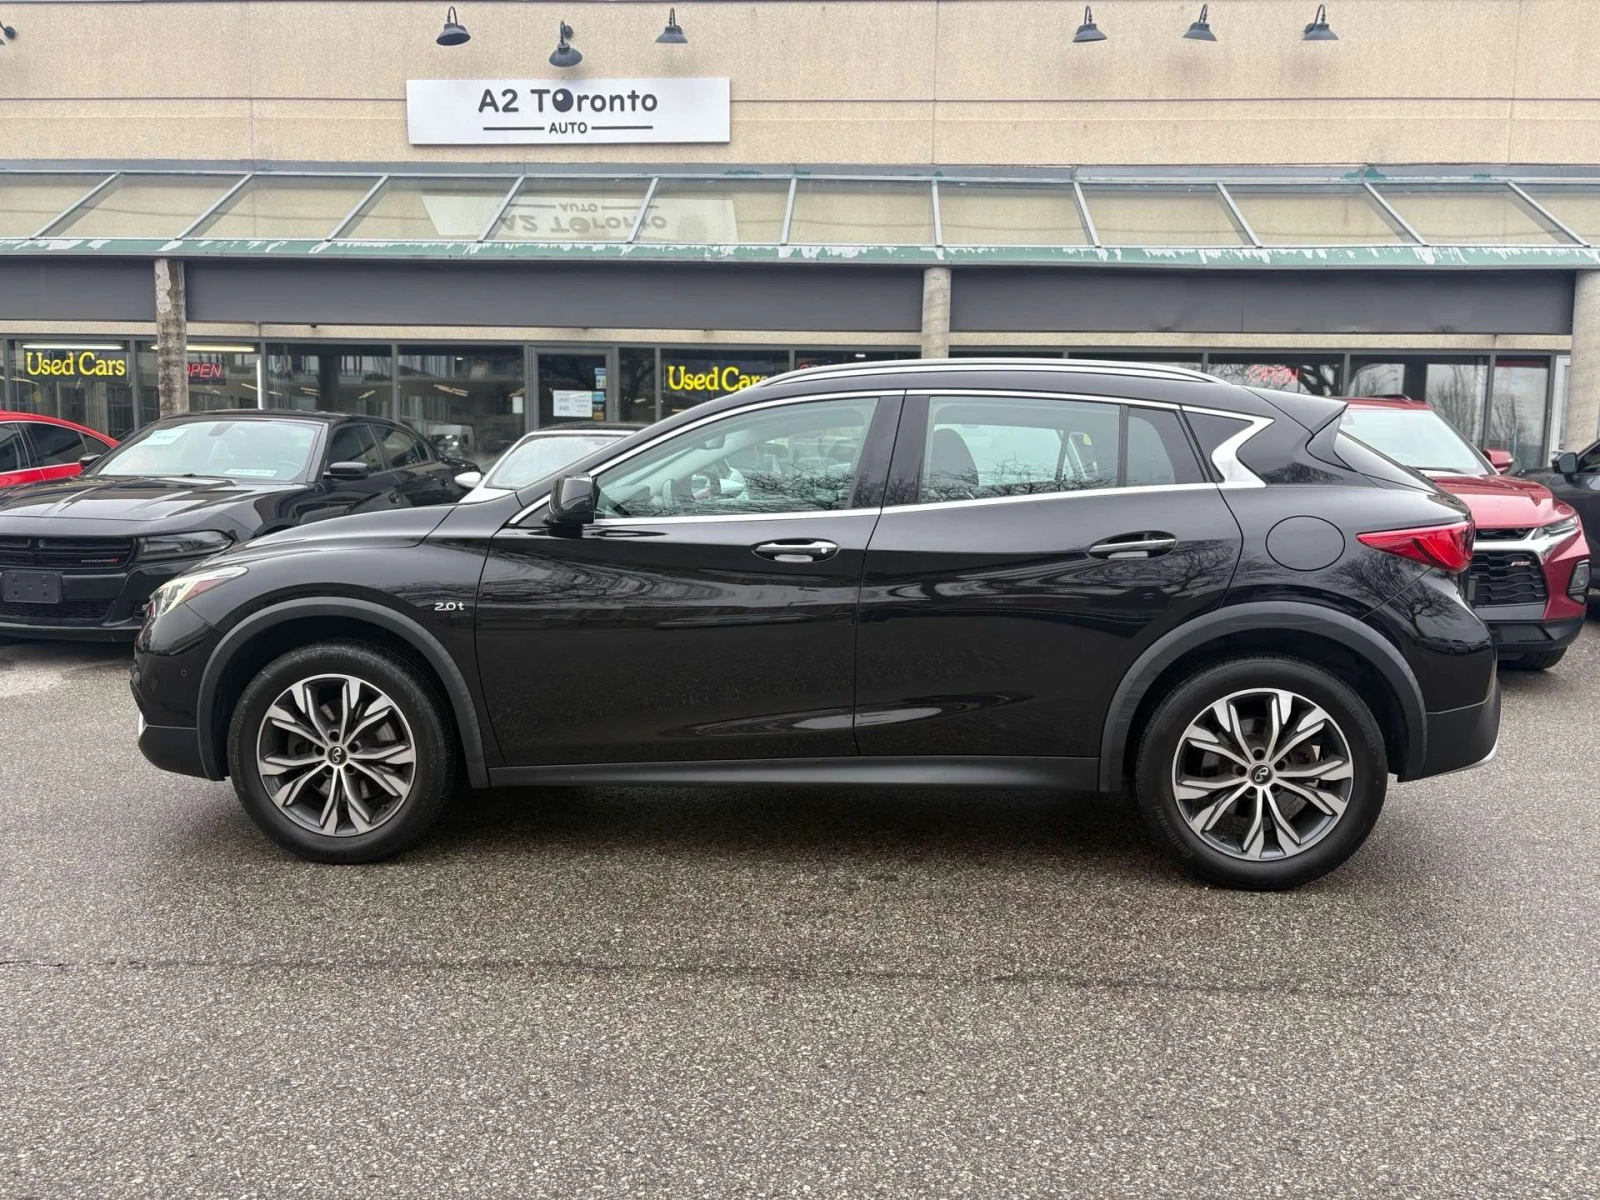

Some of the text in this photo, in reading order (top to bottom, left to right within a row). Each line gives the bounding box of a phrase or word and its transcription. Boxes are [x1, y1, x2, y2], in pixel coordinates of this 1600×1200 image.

[478, 88, 519, 113] A2
[549, 122, 587, 134] AUTO
[26, 351, 126, 376] Used Cars
[668, 365, 720, 391] Used
